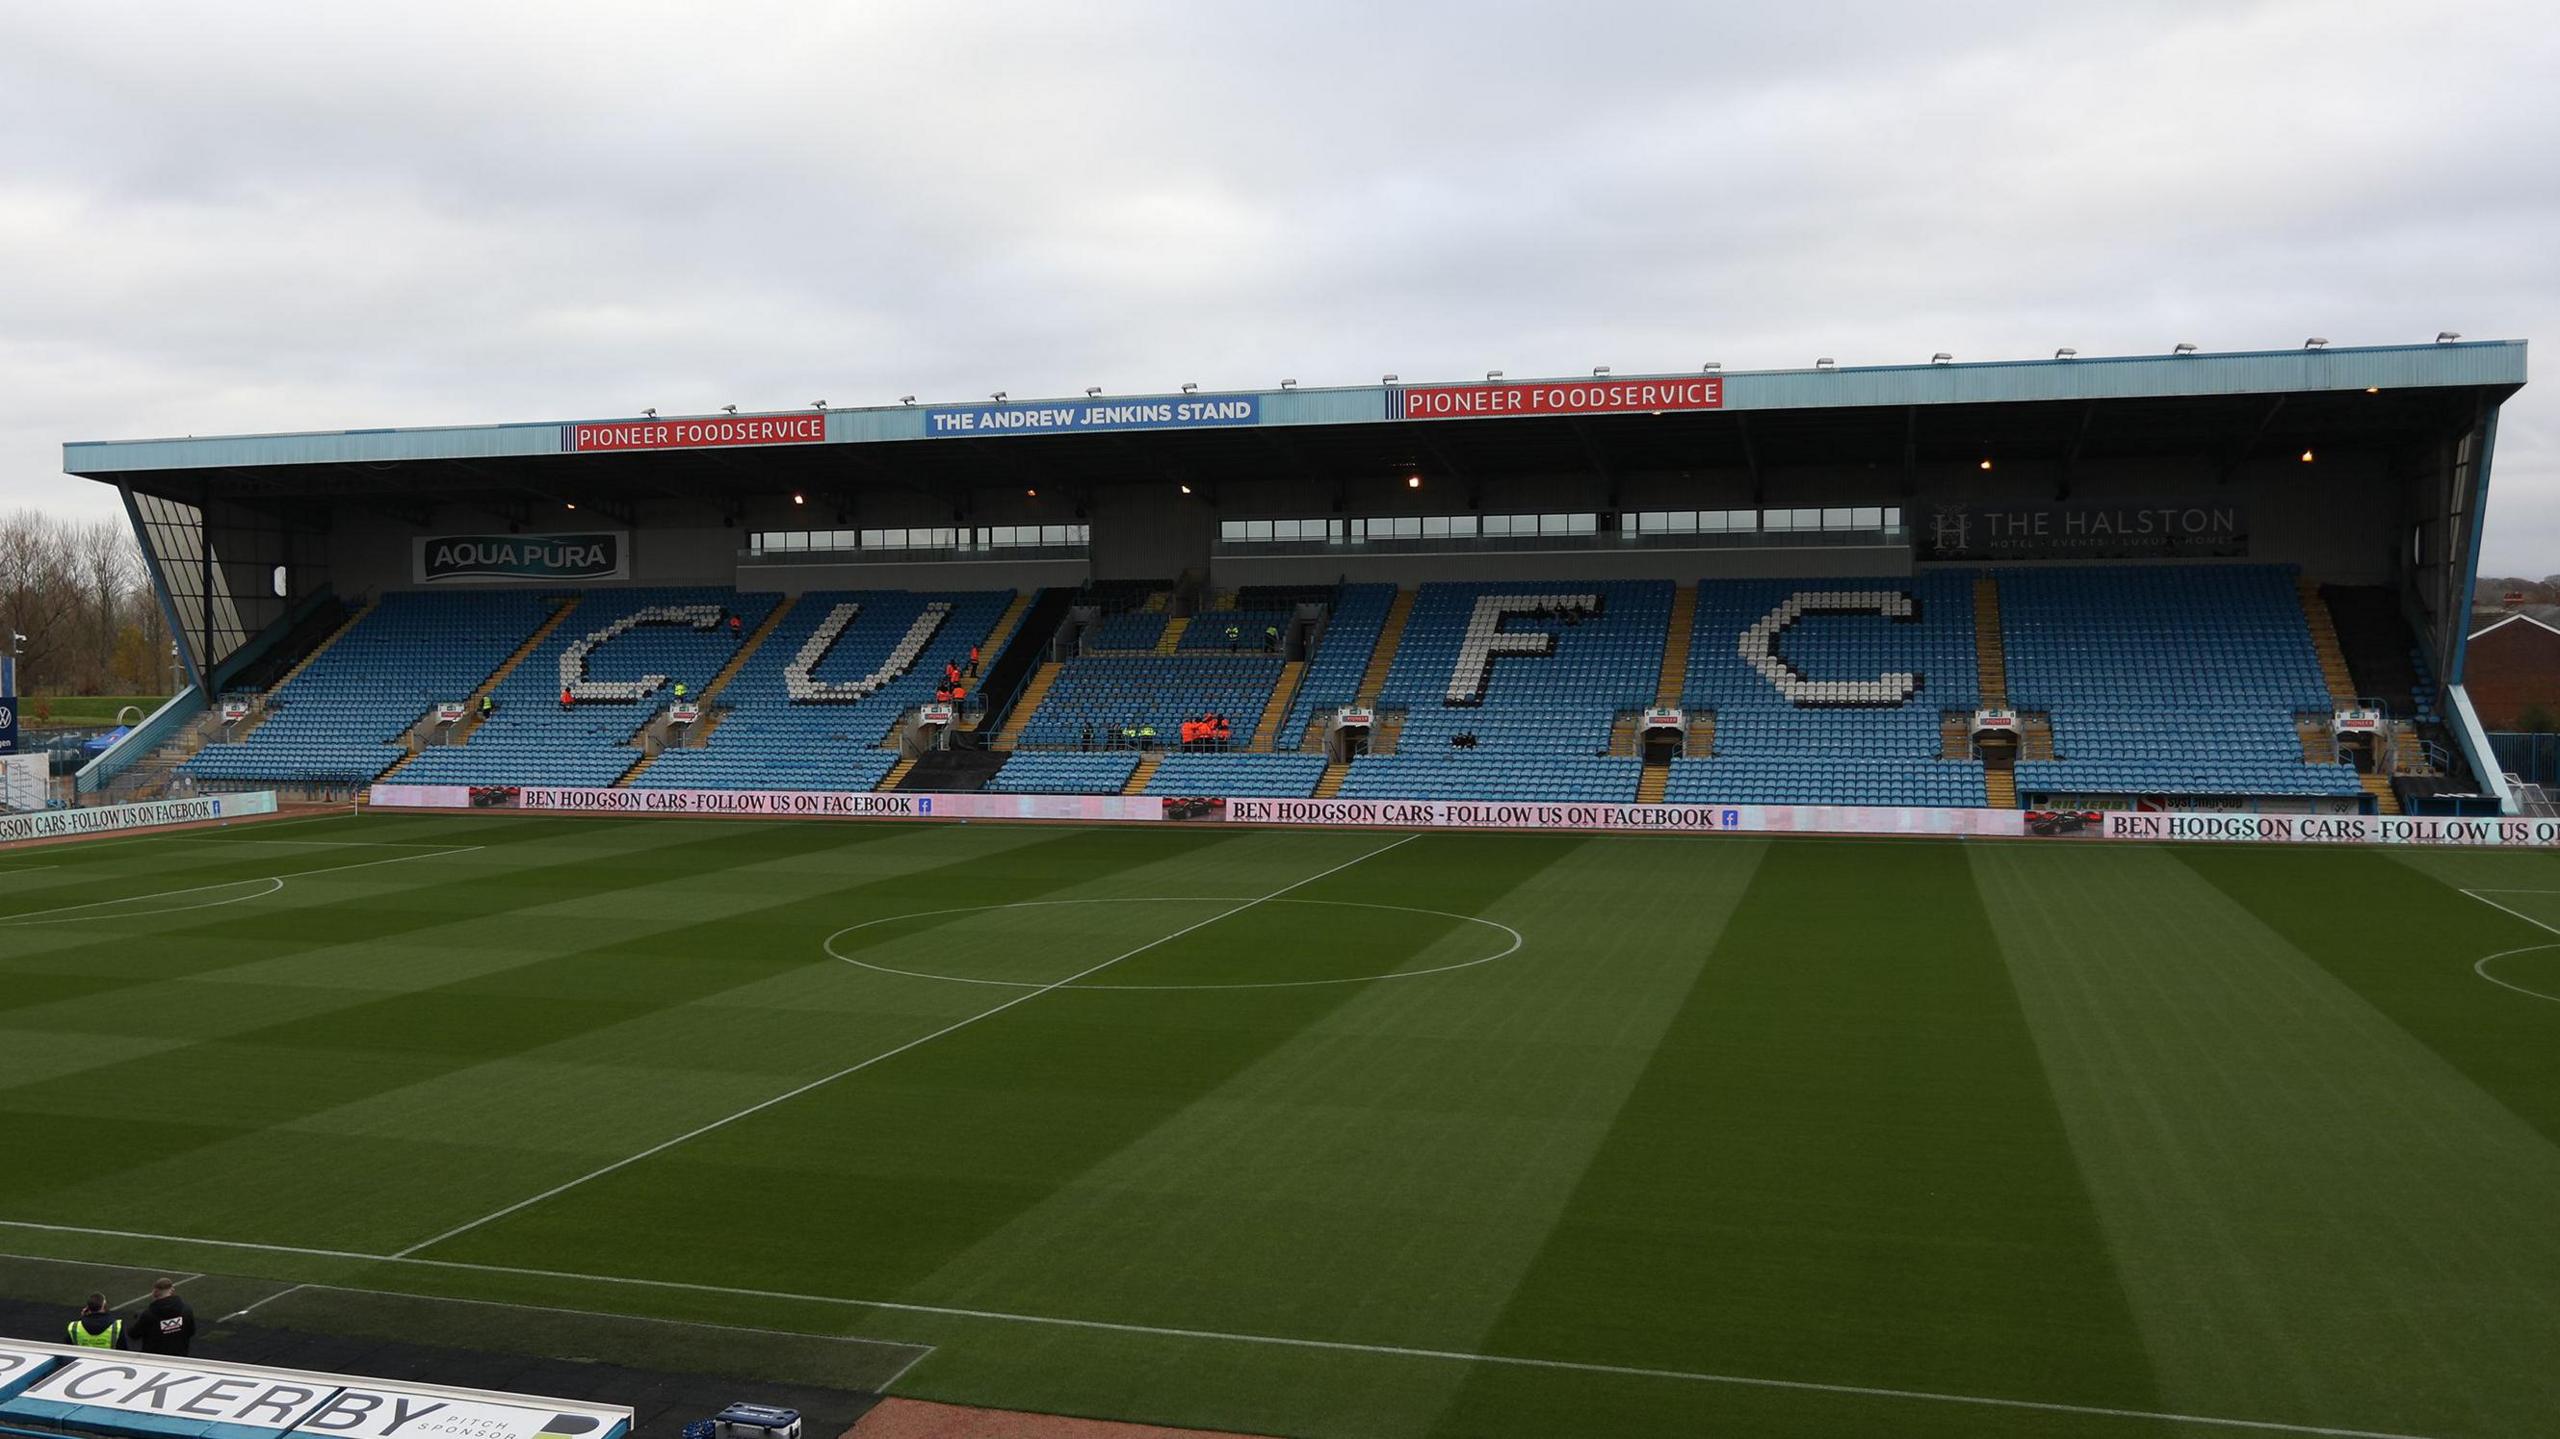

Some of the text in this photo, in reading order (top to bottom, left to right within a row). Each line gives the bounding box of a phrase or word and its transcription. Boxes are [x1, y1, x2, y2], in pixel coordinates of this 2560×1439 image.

[1410, 383, 1718, 413] PIONEER FOODSERVICE
[933, 401, 1250, 430] THE ANDREW JENKINS STAND
[580, 419, 821, 446] PIONEER FOODSERVICE
[1984, 508, 2235, 536] THE HALSTON
[434, 543, 607, 568] AQUA PURA
[526, 791, 911, 813] BEN HODGSON CARS -FOLLOW US ON FACEBOOK
[1233, 802, 1714, 827] BEN HODGSON CARS -FOLLOW US ON FACEBOOK
[36, 814, 65, 834] CARS
[68, 809, 120, 829] -FOLLOW
[123, 808, 137, 824] US
[139, 806, 154, 822] ON
[156, 801, 210, 821] FACEBOOK
[2112, 816, 2161, 835] BEN
[2167, 817, 2292, 838] HODGSON
[2301, 819, 2366, 839] CARS
[2371, 821, 2491, 840] -FOLLOW
[2497, 822, 2529, 842] US
[417, 1423, 519, 1439] SPONSOR
[446, 1415, 509, 1430] PITCH
